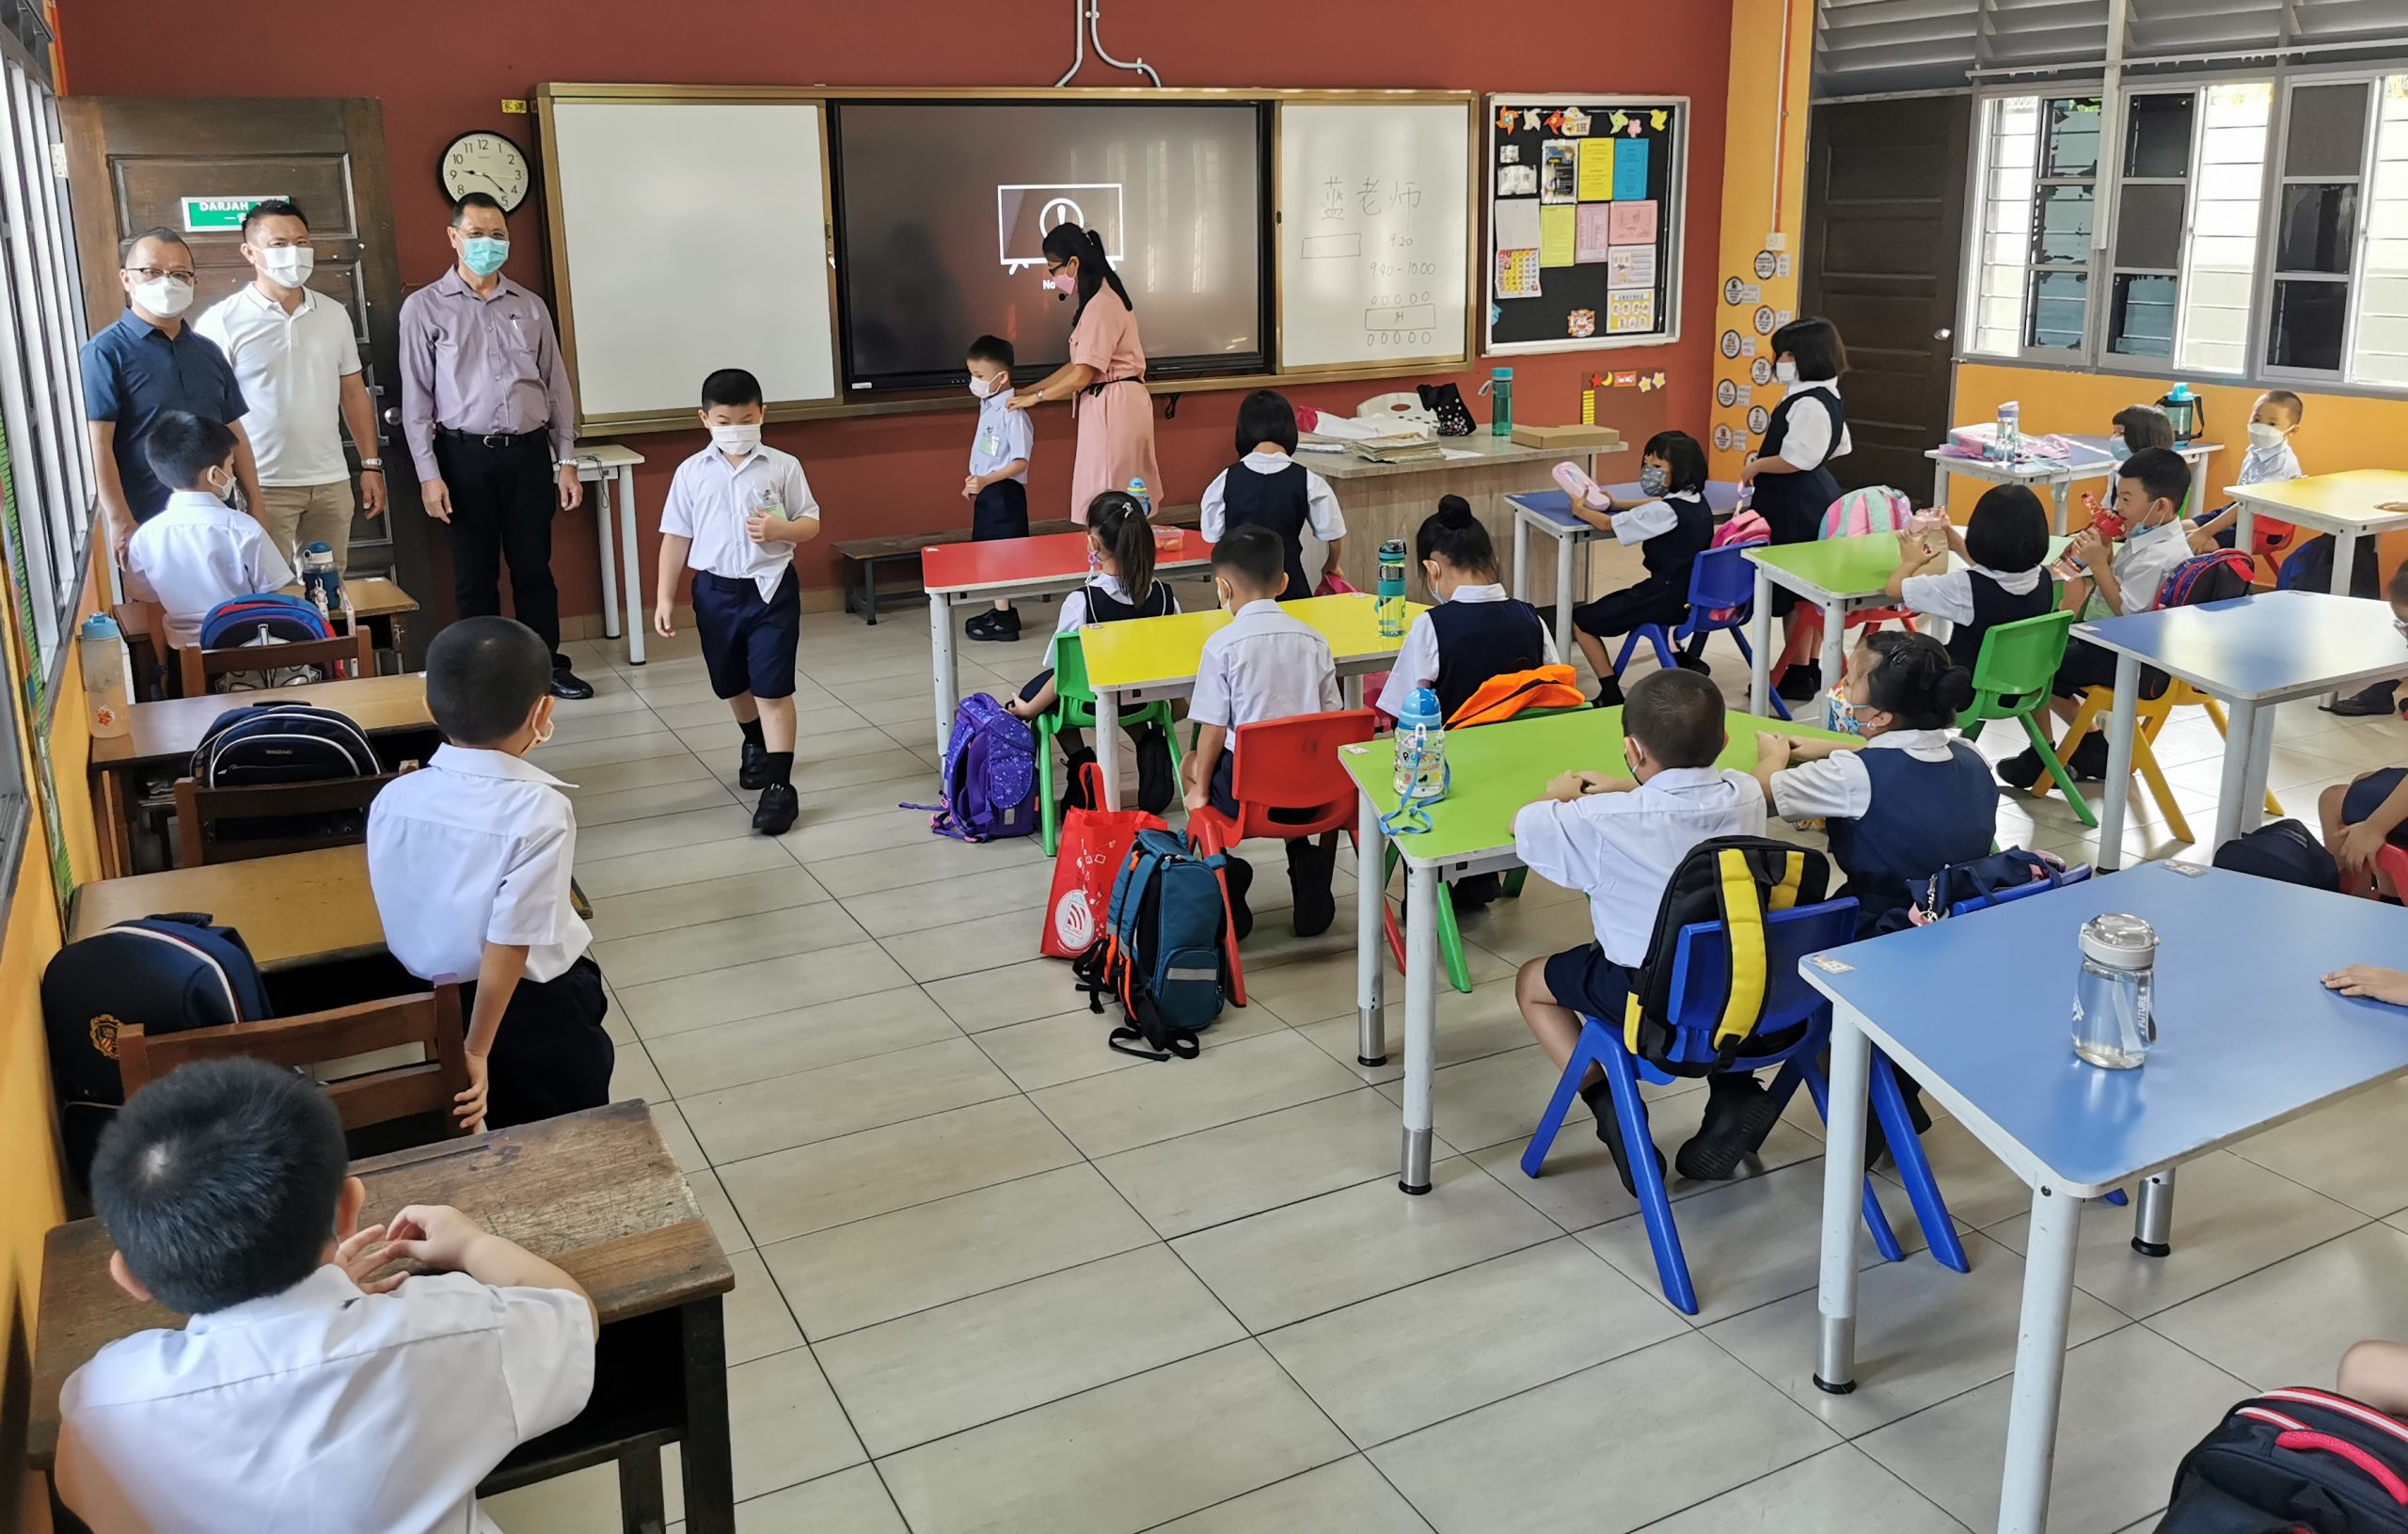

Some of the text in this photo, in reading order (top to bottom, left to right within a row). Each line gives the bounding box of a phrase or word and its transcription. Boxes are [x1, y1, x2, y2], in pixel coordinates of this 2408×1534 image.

[464, 142, 473, 153] 11
[478, 138, 489, 150] 12
[498, 143, 502, 153] 1
[452, 153, 464, 165] 10
[507, 153, 515, 166] 2
[450, 169, 457, 180] 9
[515, 170, 521, 181] 3
[457, 184, 465, 195] 8
[511, 184, 518, 194] 4
[199, 201, 249, 212] DARJAH
[500, 196, 509, 207] 5
[1321, 175, 1421, 231] 蓝老师
[1042, 279, 1055, 290] No
[2137, 995, 2147, 1030] FUTURE
